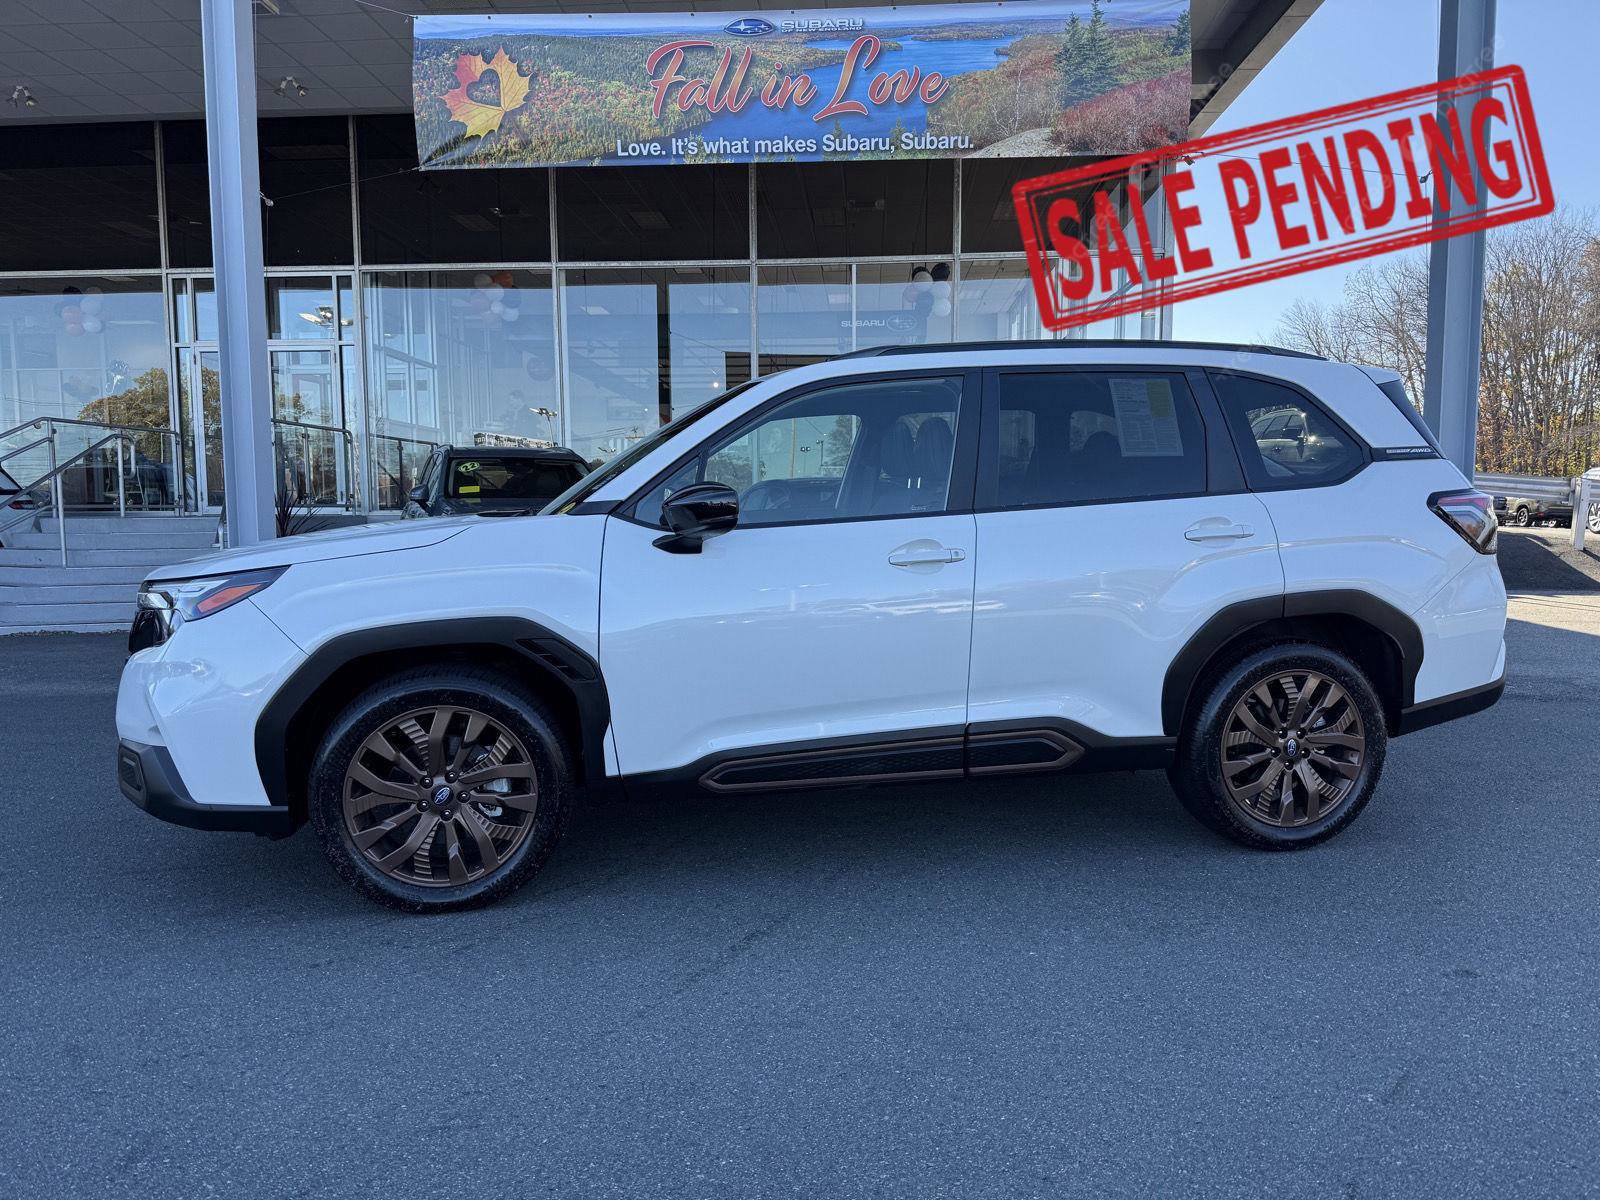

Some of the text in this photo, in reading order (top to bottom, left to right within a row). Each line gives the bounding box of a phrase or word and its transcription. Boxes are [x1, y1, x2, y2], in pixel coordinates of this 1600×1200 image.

[781, 18, 863, 29] SUBARU
[646, 35, 949, 121] Fall in Love
[617, 131, 974, 157] Love. It's what makes Subaru, Subaru.
[840, 319, 885, 328] SUBARU
